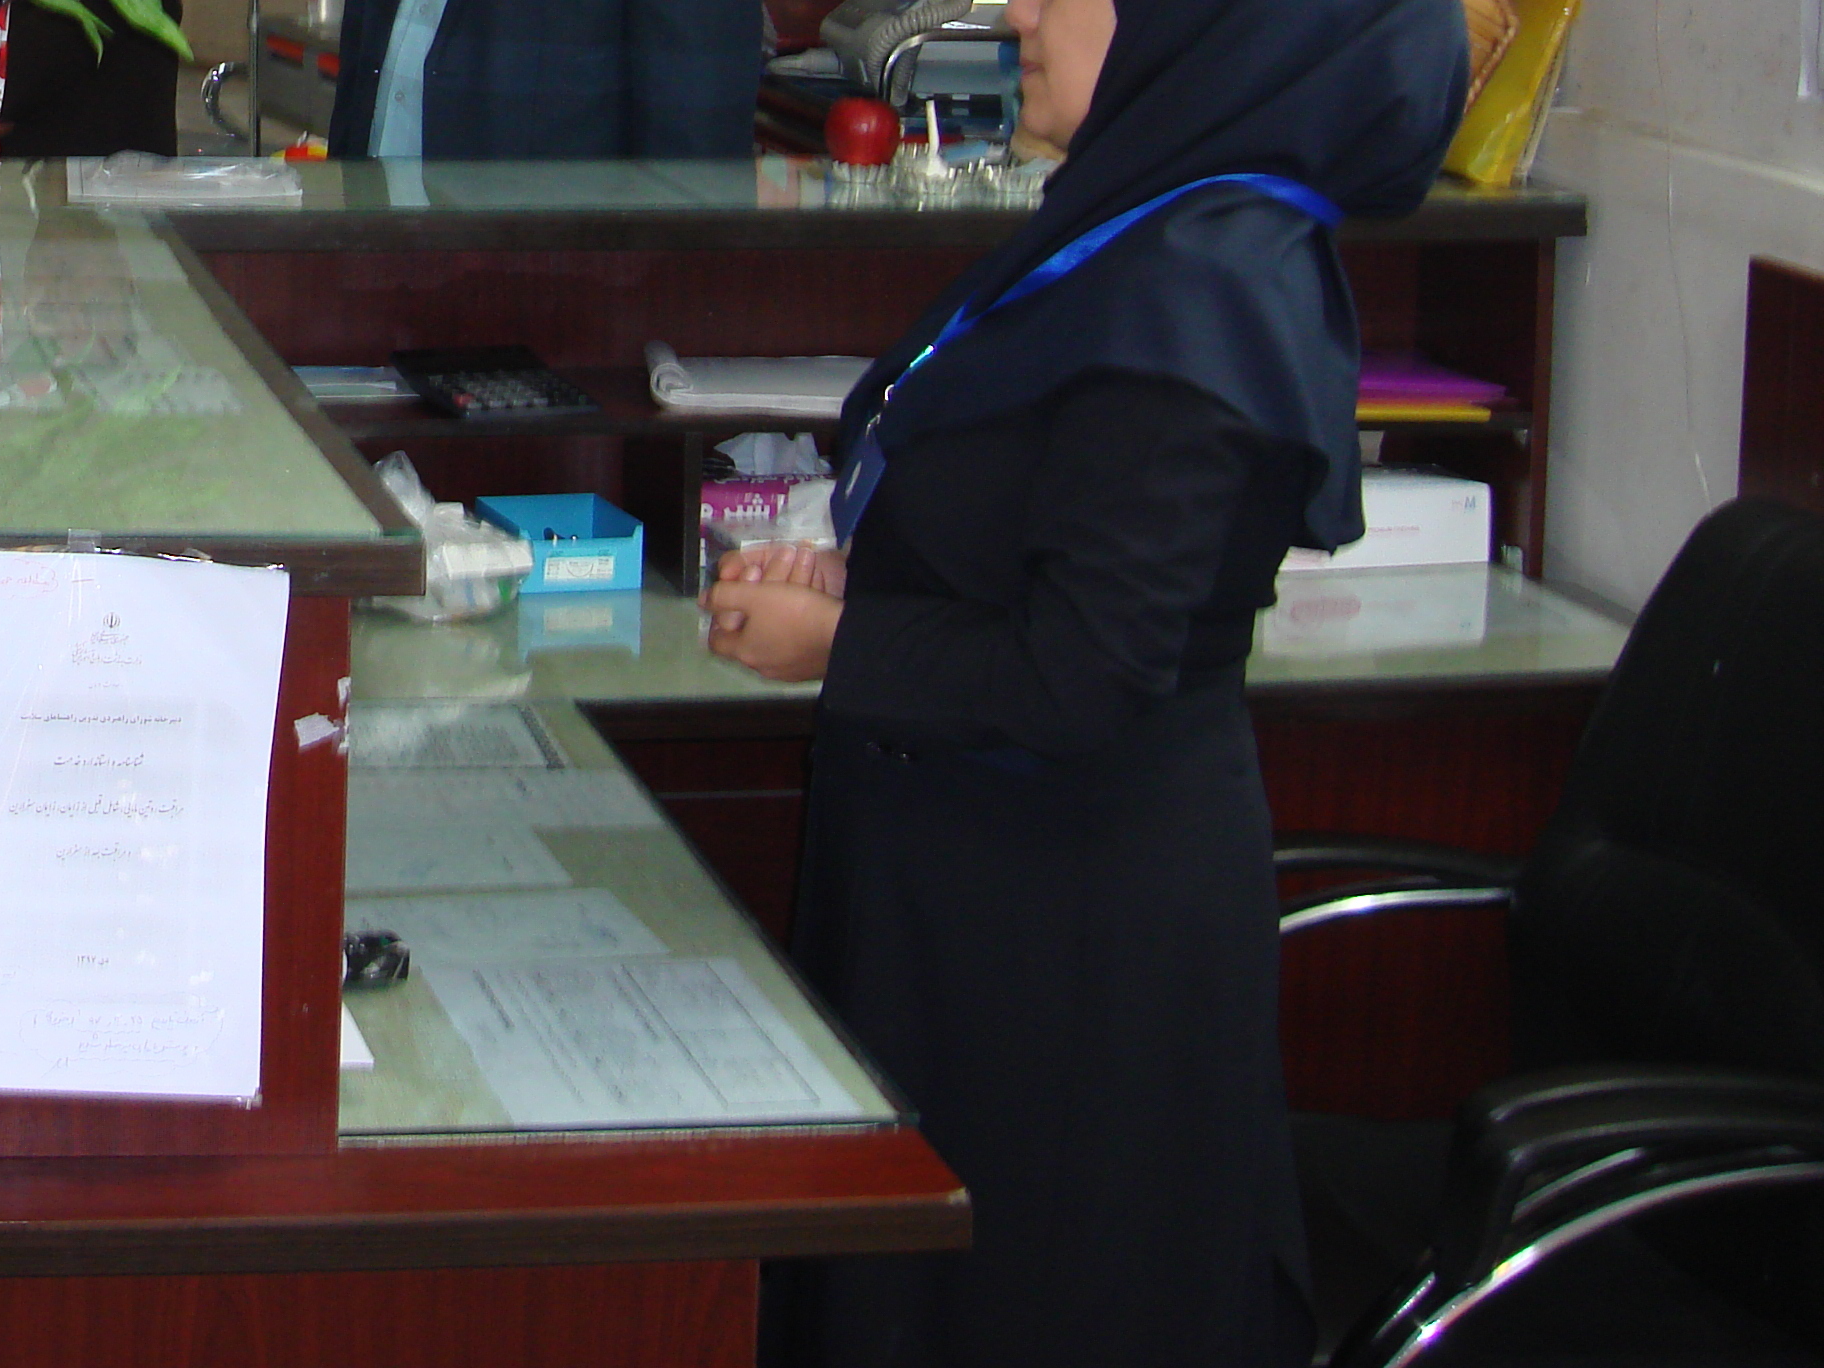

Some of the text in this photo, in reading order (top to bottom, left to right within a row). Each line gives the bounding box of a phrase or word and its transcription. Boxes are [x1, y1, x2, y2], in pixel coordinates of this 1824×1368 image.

[87, 793, 102, 815] قبل
[102, 799, 119, 815] شامل
[157, 798, 185, 819] مراقبت
[101, 841, 126, 862] مراقبت
